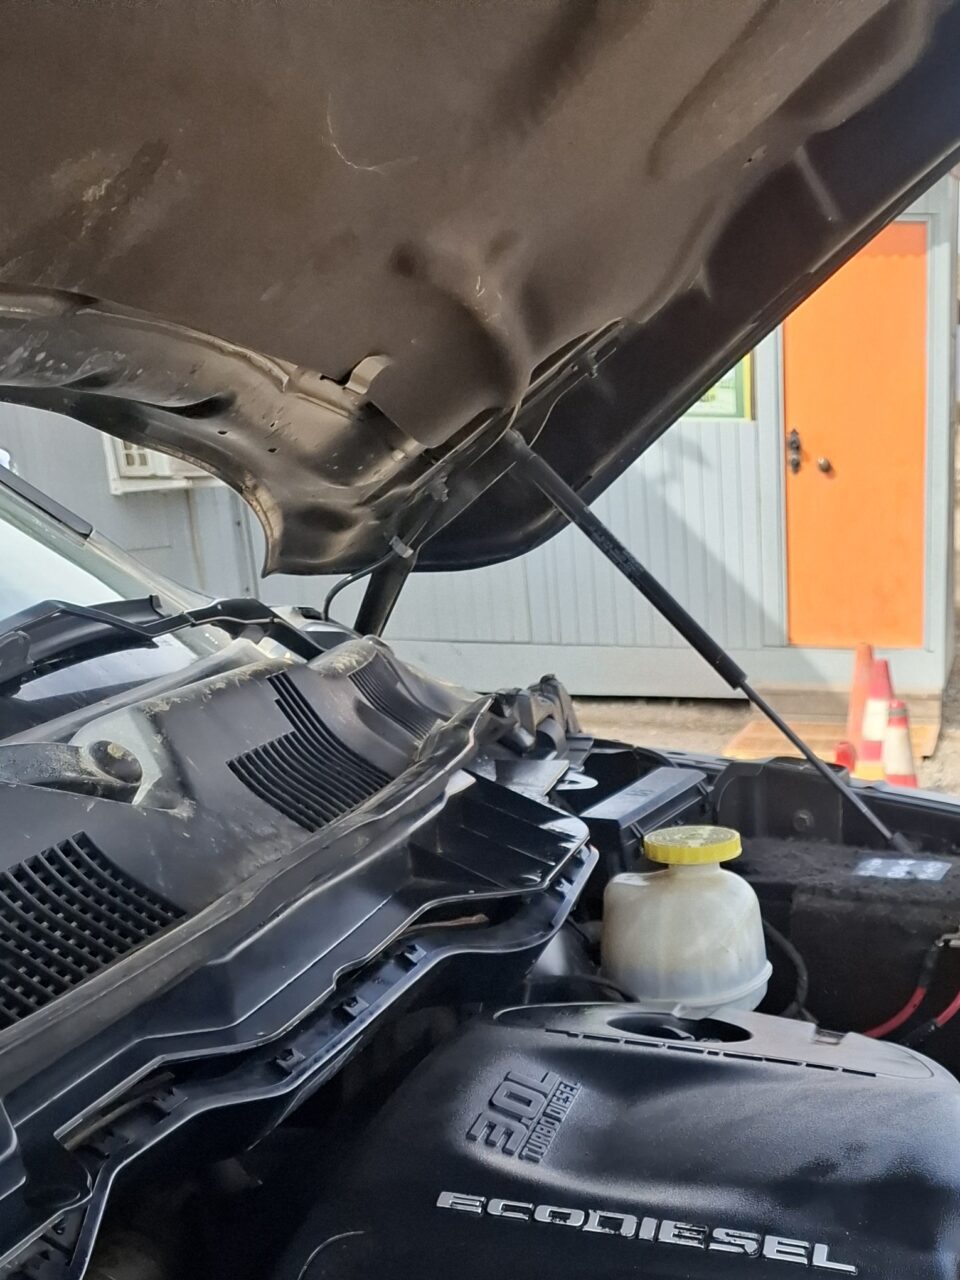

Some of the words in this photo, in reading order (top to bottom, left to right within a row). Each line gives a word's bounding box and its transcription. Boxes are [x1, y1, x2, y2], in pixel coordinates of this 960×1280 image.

[466, 1071, 560, 1156] 3.0L
[518, 1116, 561, 1163] TURBO
[543, 1079, 582, 1122] DIESEL
[436, 1191, 858, 1275] ECODIESEL
